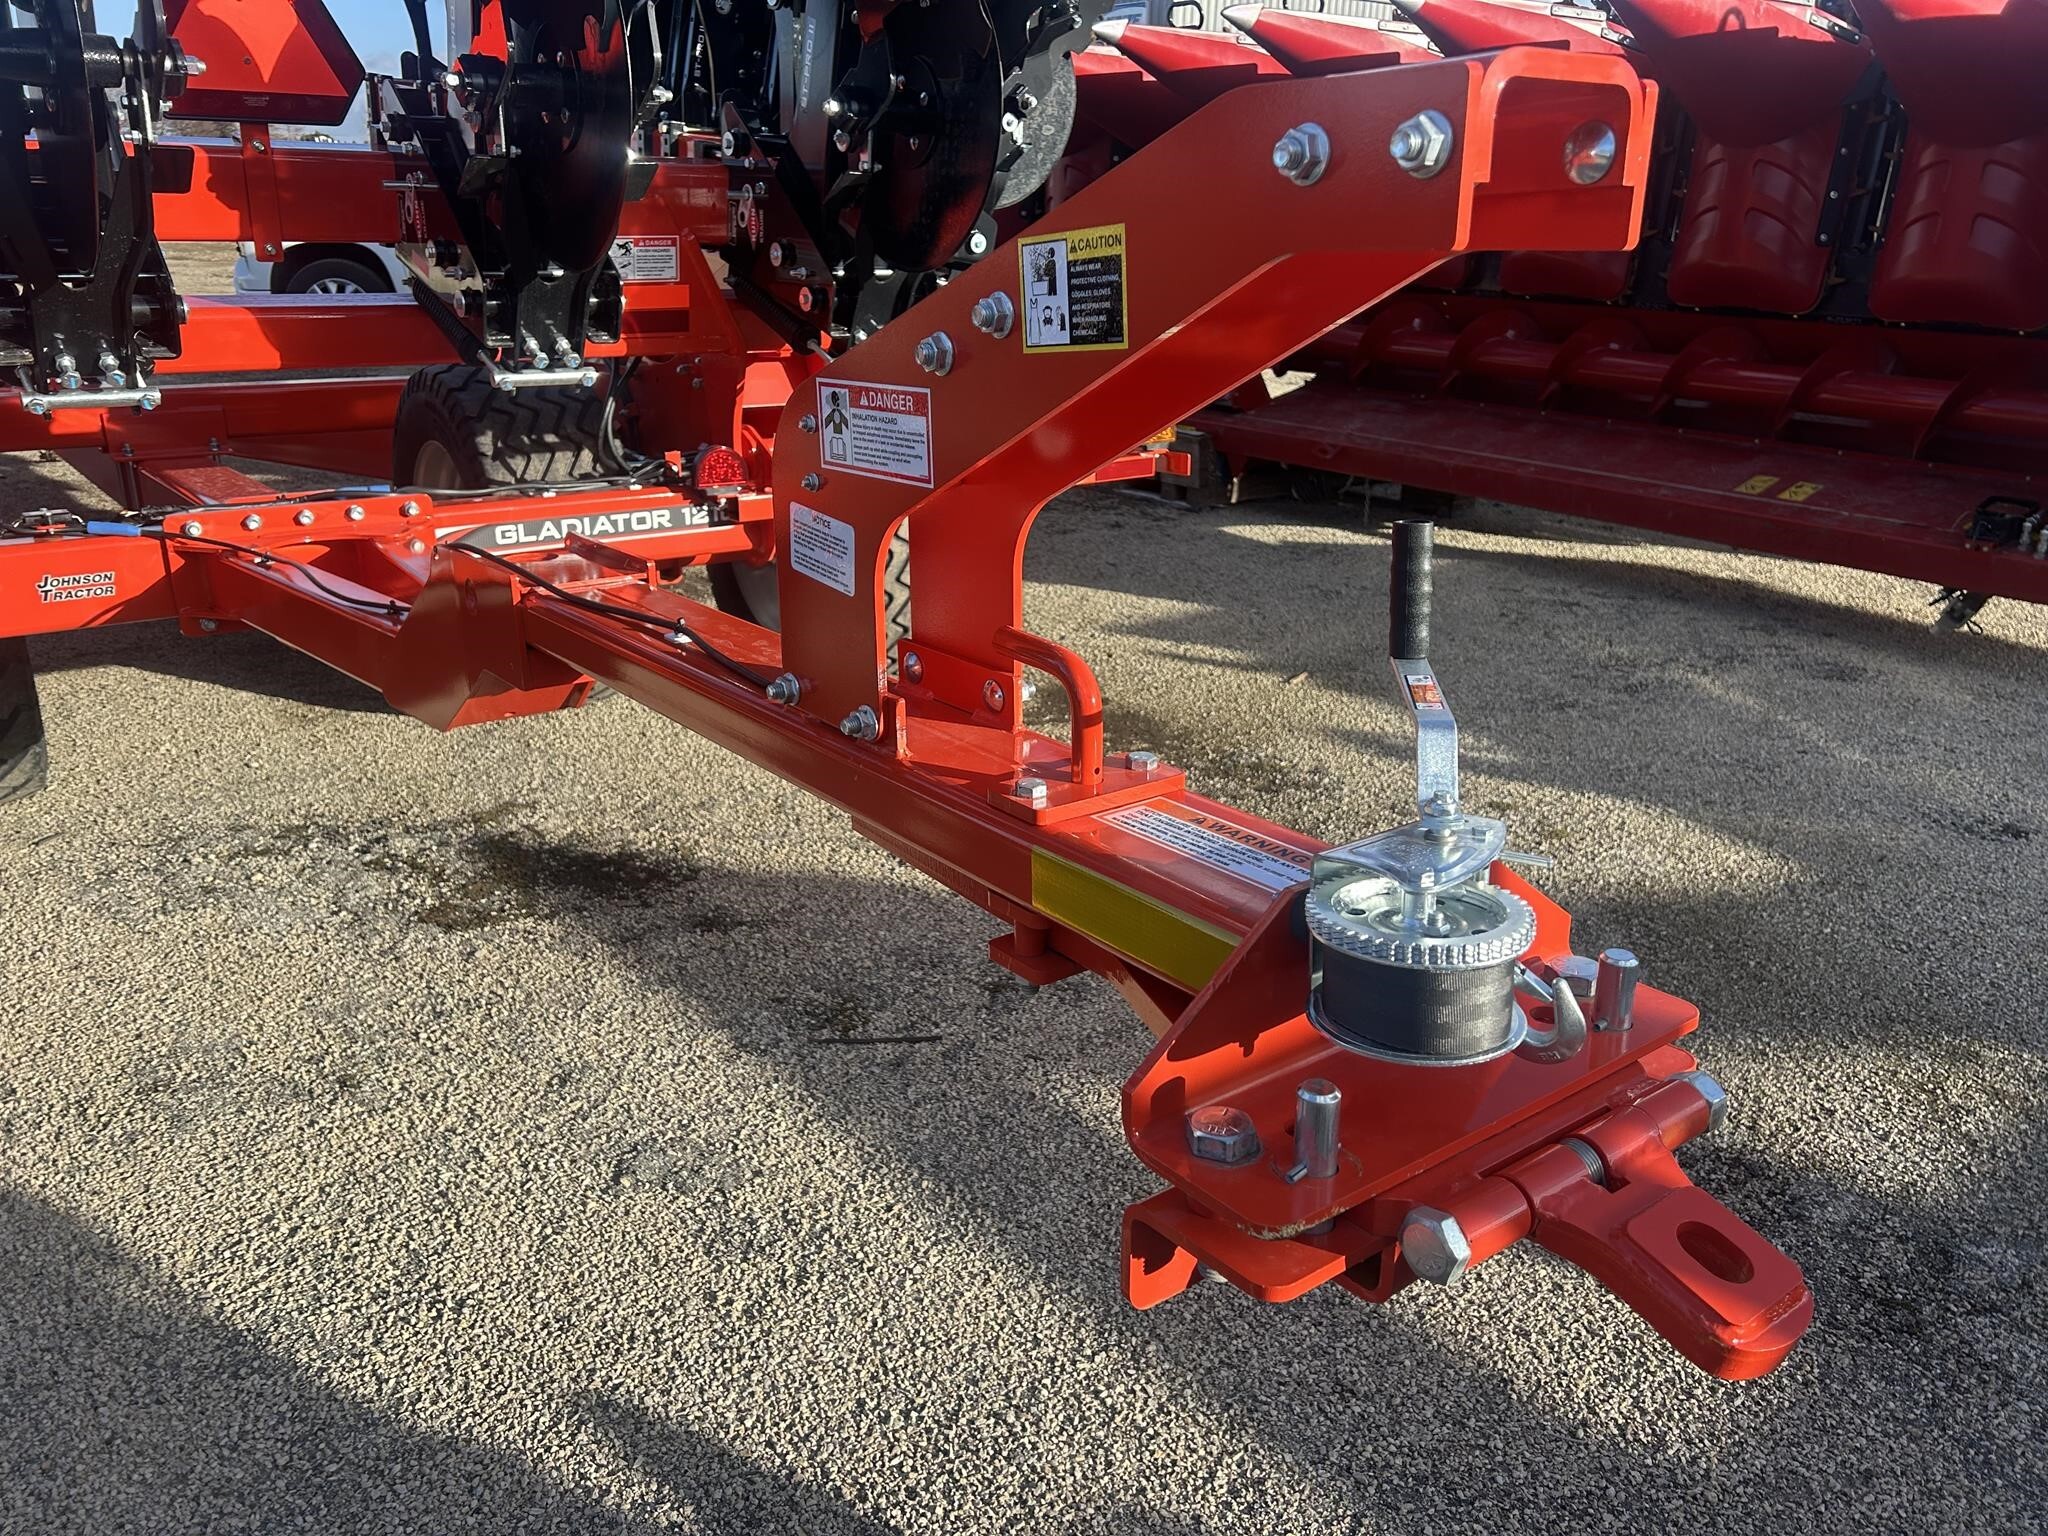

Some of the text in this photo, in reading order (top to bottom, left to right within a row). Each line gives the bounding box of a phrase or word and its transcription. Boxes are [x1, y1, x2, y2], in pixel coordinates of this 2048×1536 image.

[1078, 233, 1121, 251] CAUTION
[1071, 276, 1096, 285] PROTECTIVE
[870, 392, 913, 411] DANGER
[852, 413, 897, 425] INHALATION HAZARD
[495, 509, 673, 545] GLADIATOR
[37, 573, 113, 589] JOHNSON
[40, 586, 114, 602] TRACTOR
[1208, 822, 1311, 863] WARNING
